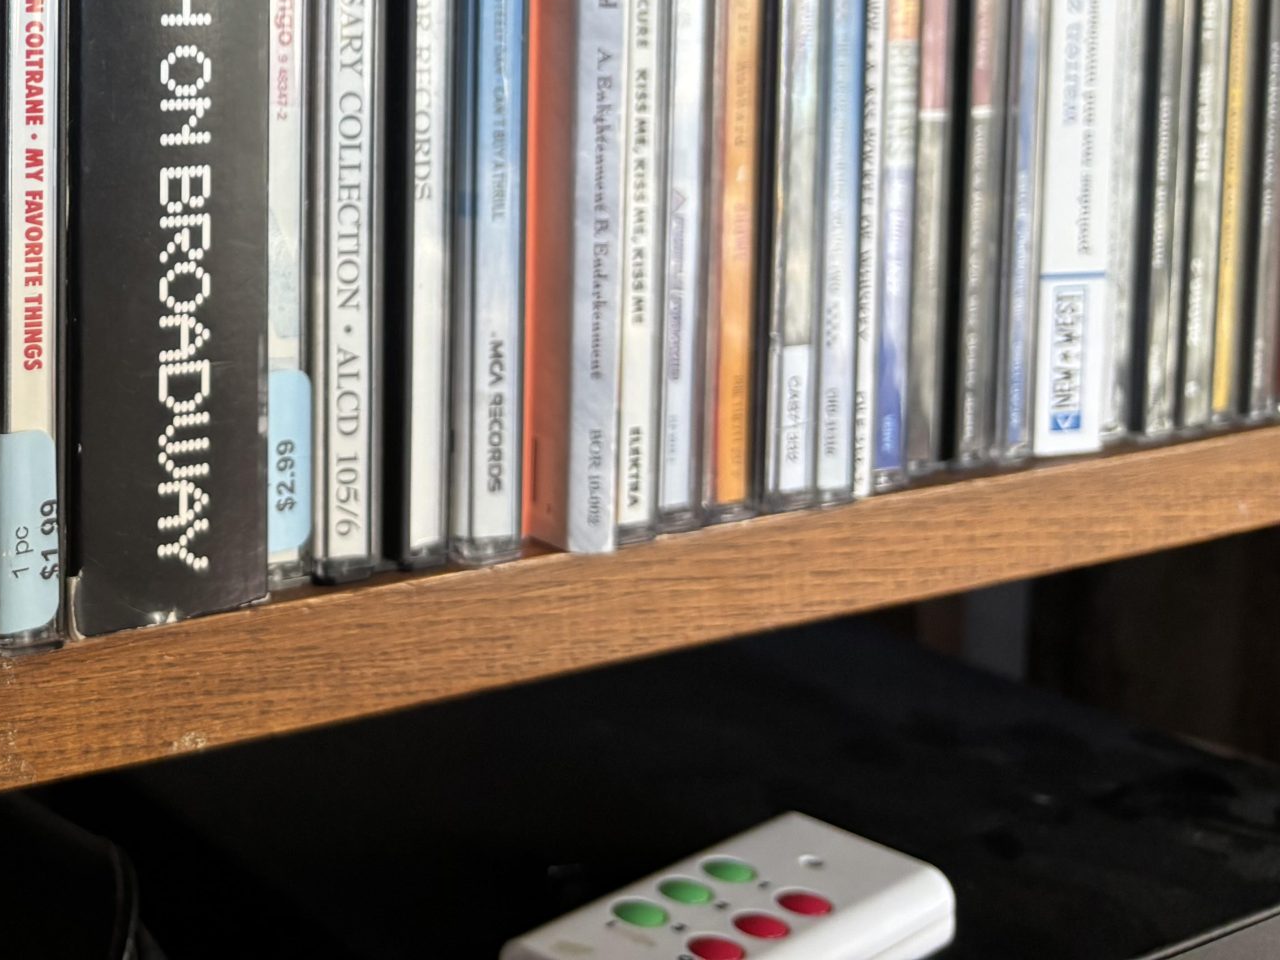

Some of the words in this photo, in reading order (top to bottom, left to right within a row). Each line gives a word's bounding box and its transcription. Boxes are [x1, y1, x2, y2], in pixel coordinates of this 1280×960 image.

[24, 20, 44, 127] COLTRANE
[159, 44, 212, 148] ON
[635, 68, 649, 113] KISS
[24, 148, 44, 182] MY
[335, 91, 363, 311] COLLECTION
[633, 158, 647, 202] KISS
[23, 189, 44, 289] FAVORITE
[631, 247, 646, 292] KISS
[22, 293, 44, 372] THINGS
[630, 295, 645, 325] ME
[157, 164, 211, 571] BROADWAY
[335, 345, 362, 437] ALCD
[488, 339, 505, 386] MCA
[275, 440, 297, 513] $2.99
[487, 393, 504, 493] RECORDS
[626, 426, 641, 508] ELEKTRA
[334, 452, 361, 537] 105/6
[11, 567, 31, 579] 1
[14, 526, 32, 555] pc
